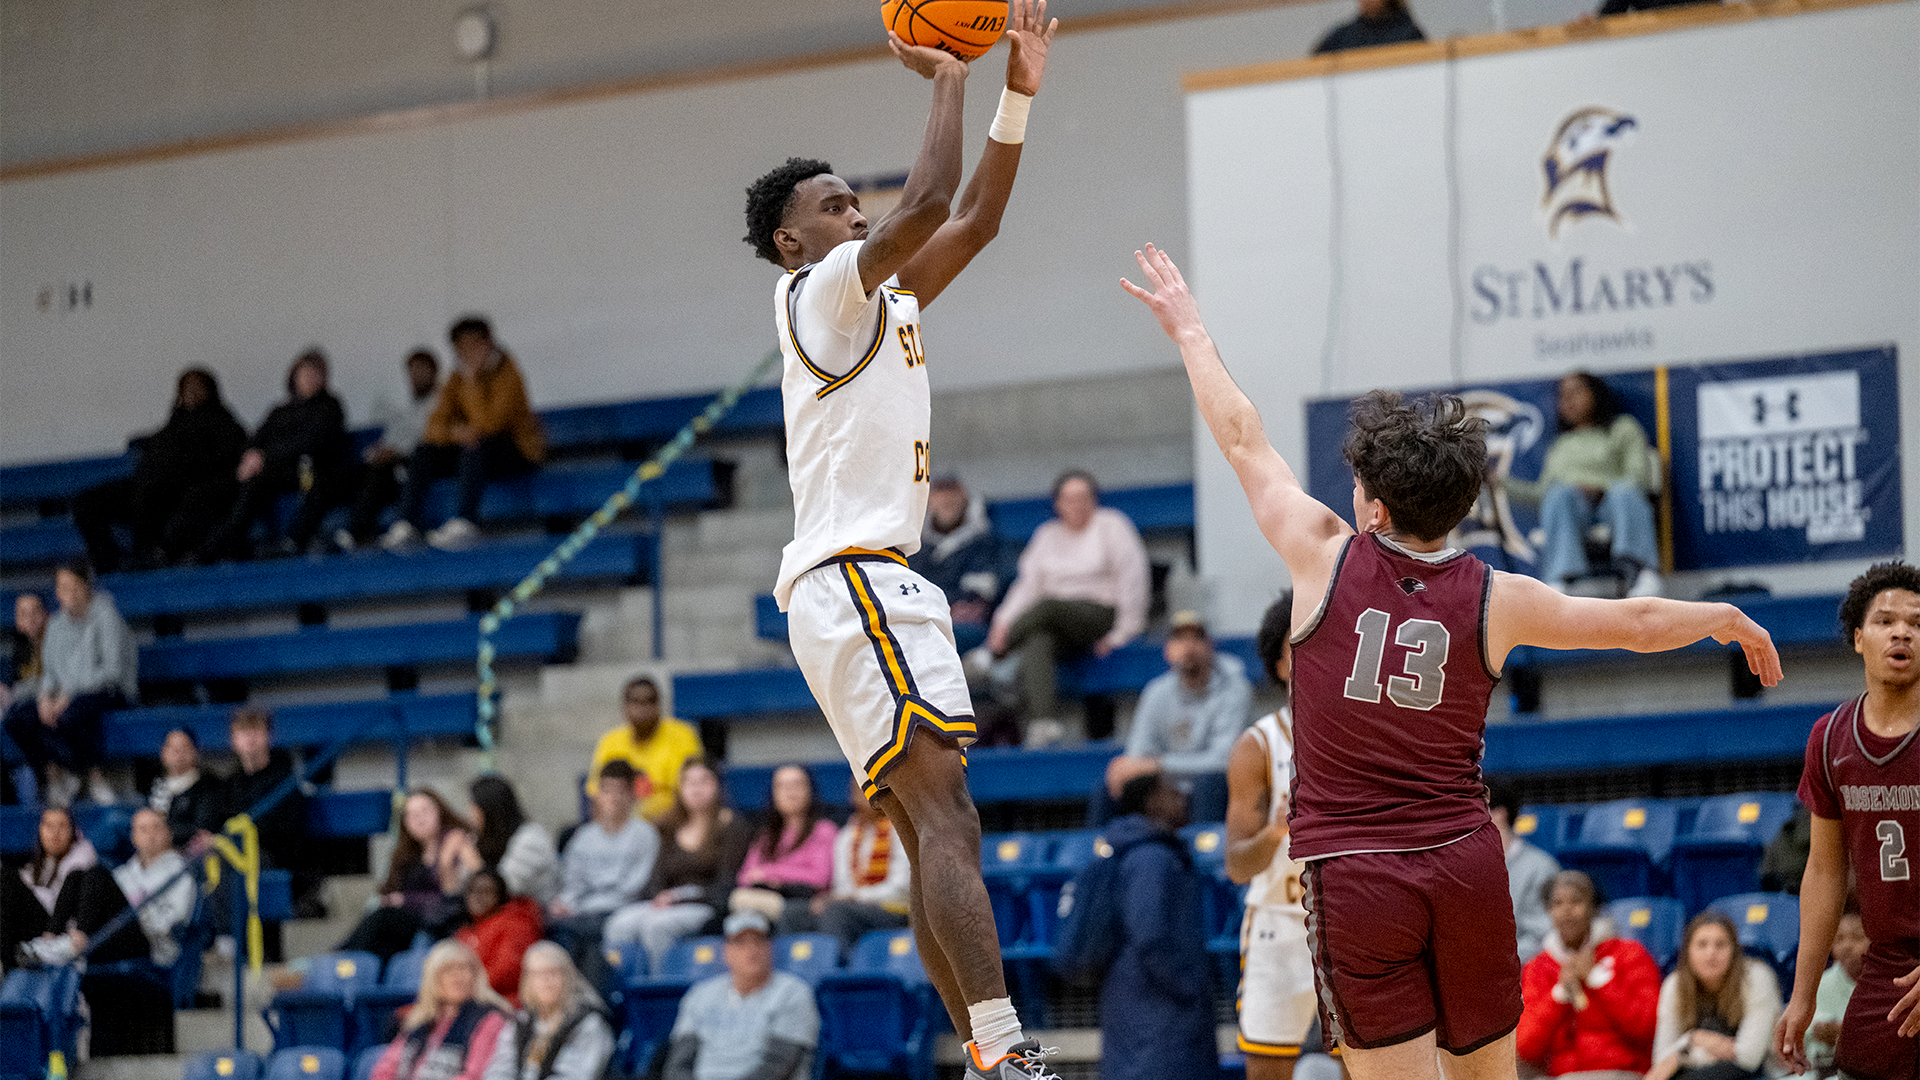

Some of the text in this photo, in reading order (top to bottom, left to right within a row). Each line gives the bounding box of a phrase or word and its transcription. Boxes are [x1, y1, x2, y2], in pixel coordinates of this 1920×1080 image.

[1699, 430, 1857, 490] PROTECT
[1701, 488, 1765, 535] THIS
[1766, 480, 1863, 530] HOUSE
[1343, 607, 1450, 711] 13
[1875, 820, 1910, 881] 2
